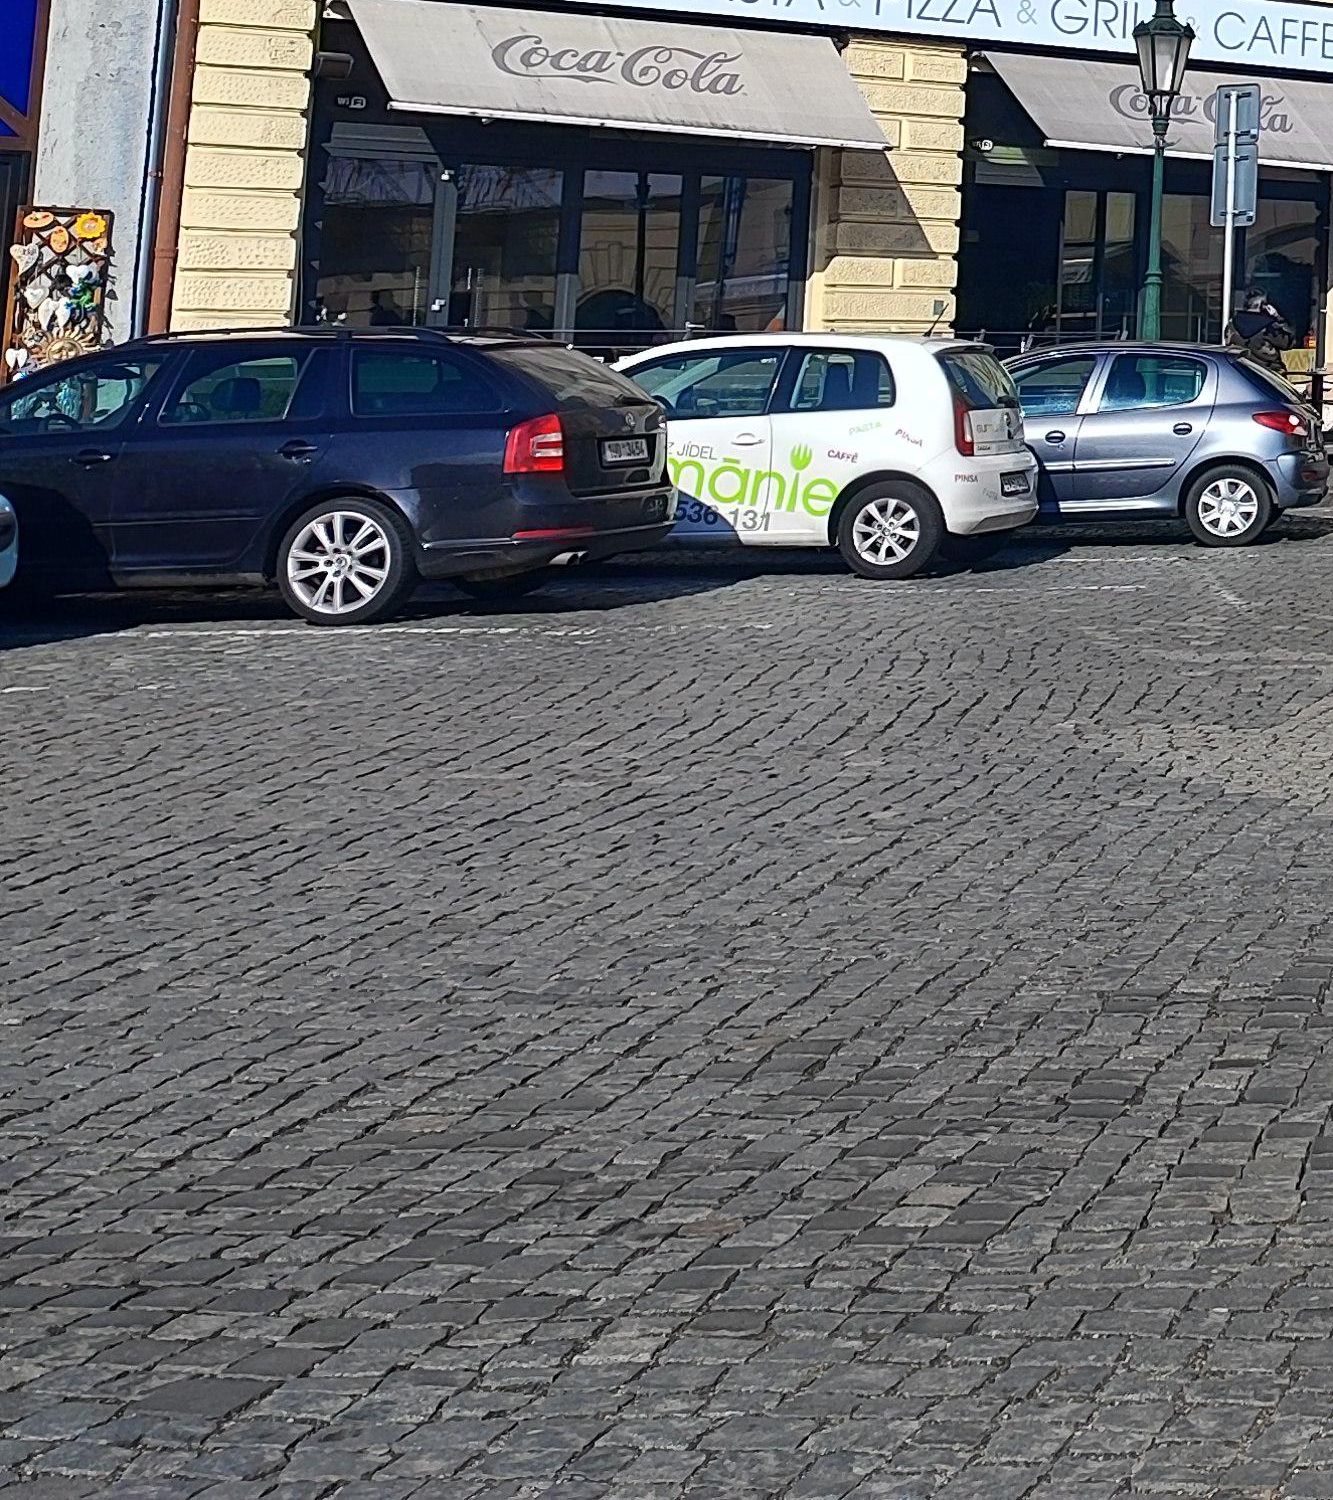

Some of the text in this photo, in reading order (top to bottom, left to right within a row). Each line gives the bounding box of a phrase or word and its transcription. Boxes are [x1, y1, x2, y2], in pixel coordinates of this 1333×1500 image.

[491, 34, 745, 97] Coca-Cola
[1109, 84, 1294, 134] Coa-la
[676, 441, 718, 460] JÍDEL
[728, 508, 771, 532] 131
